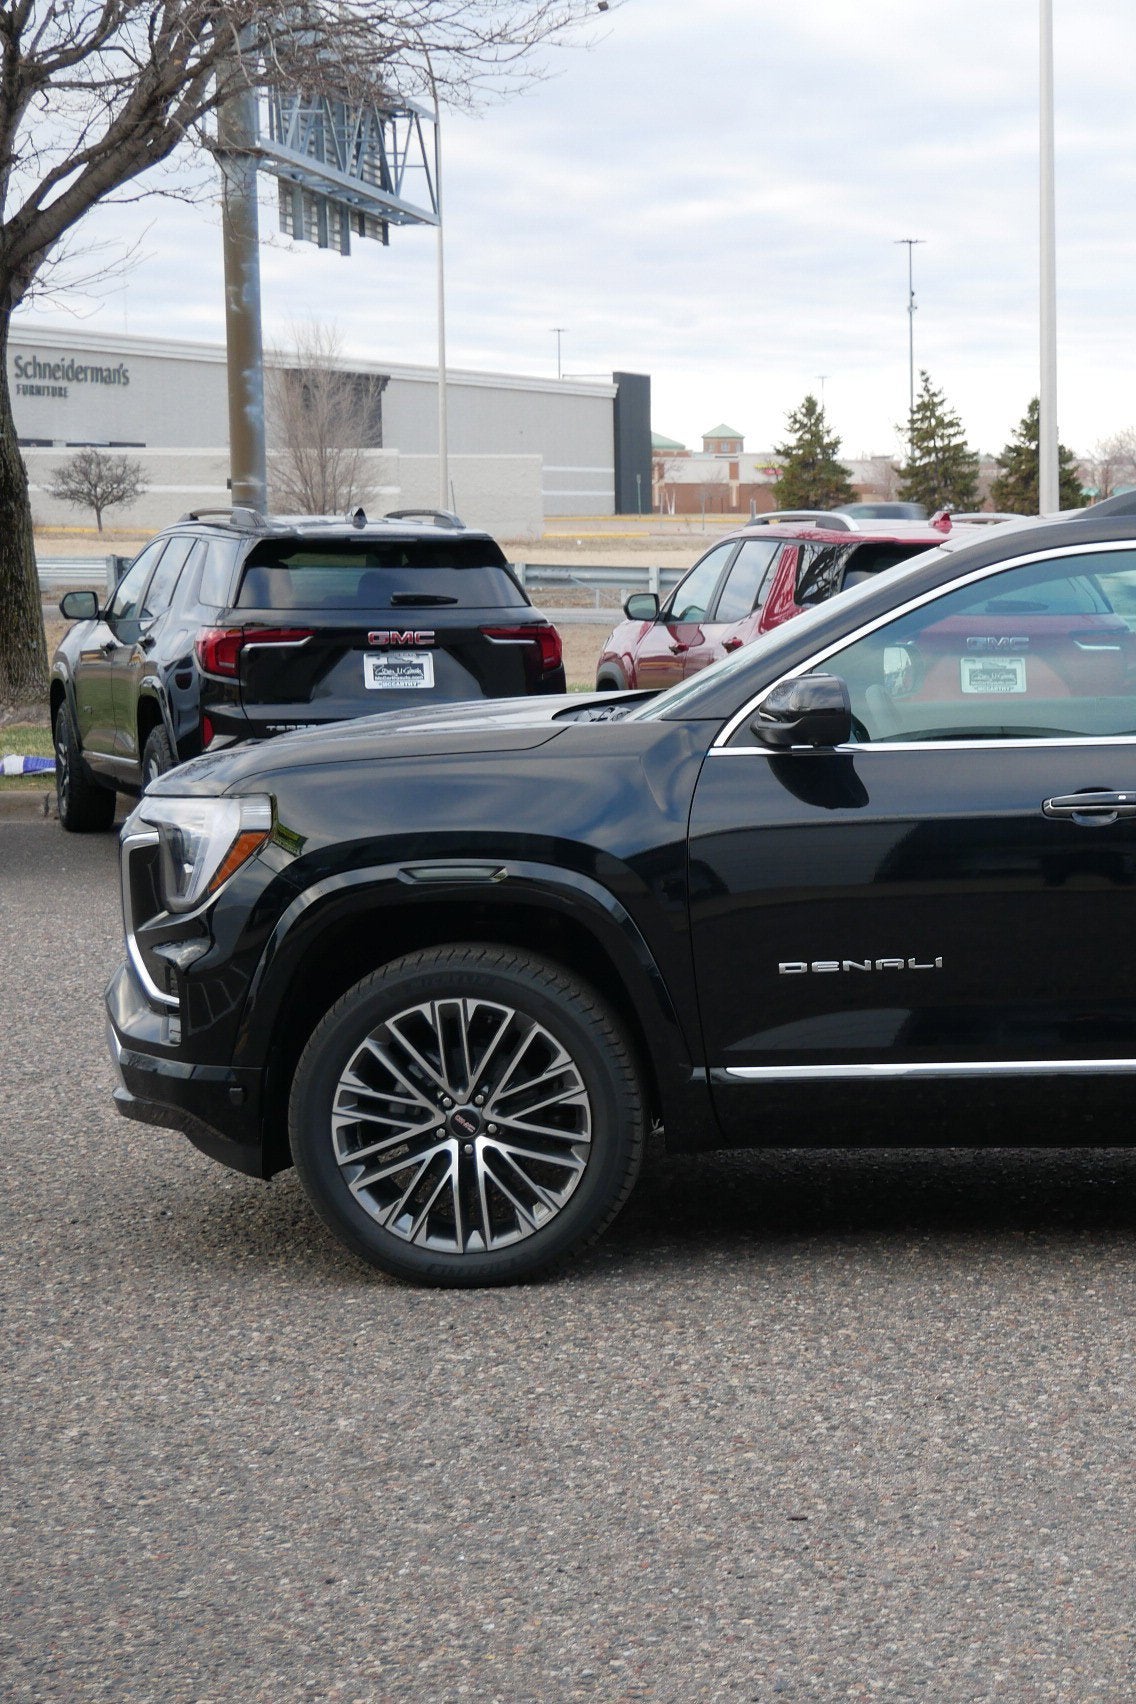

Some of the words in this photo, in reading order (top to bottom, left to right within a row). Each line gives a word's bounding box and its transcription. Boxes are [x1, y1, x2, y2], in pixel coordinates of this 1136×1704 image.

[14, 355, 130, 386] Schneiderman's
[16, 384, 68, 398] FURNITURE
[368, 630, 435, 645] GMC
[966, 636, 1030, 650] GMC
[778, 956, 943, 974] DENALI
